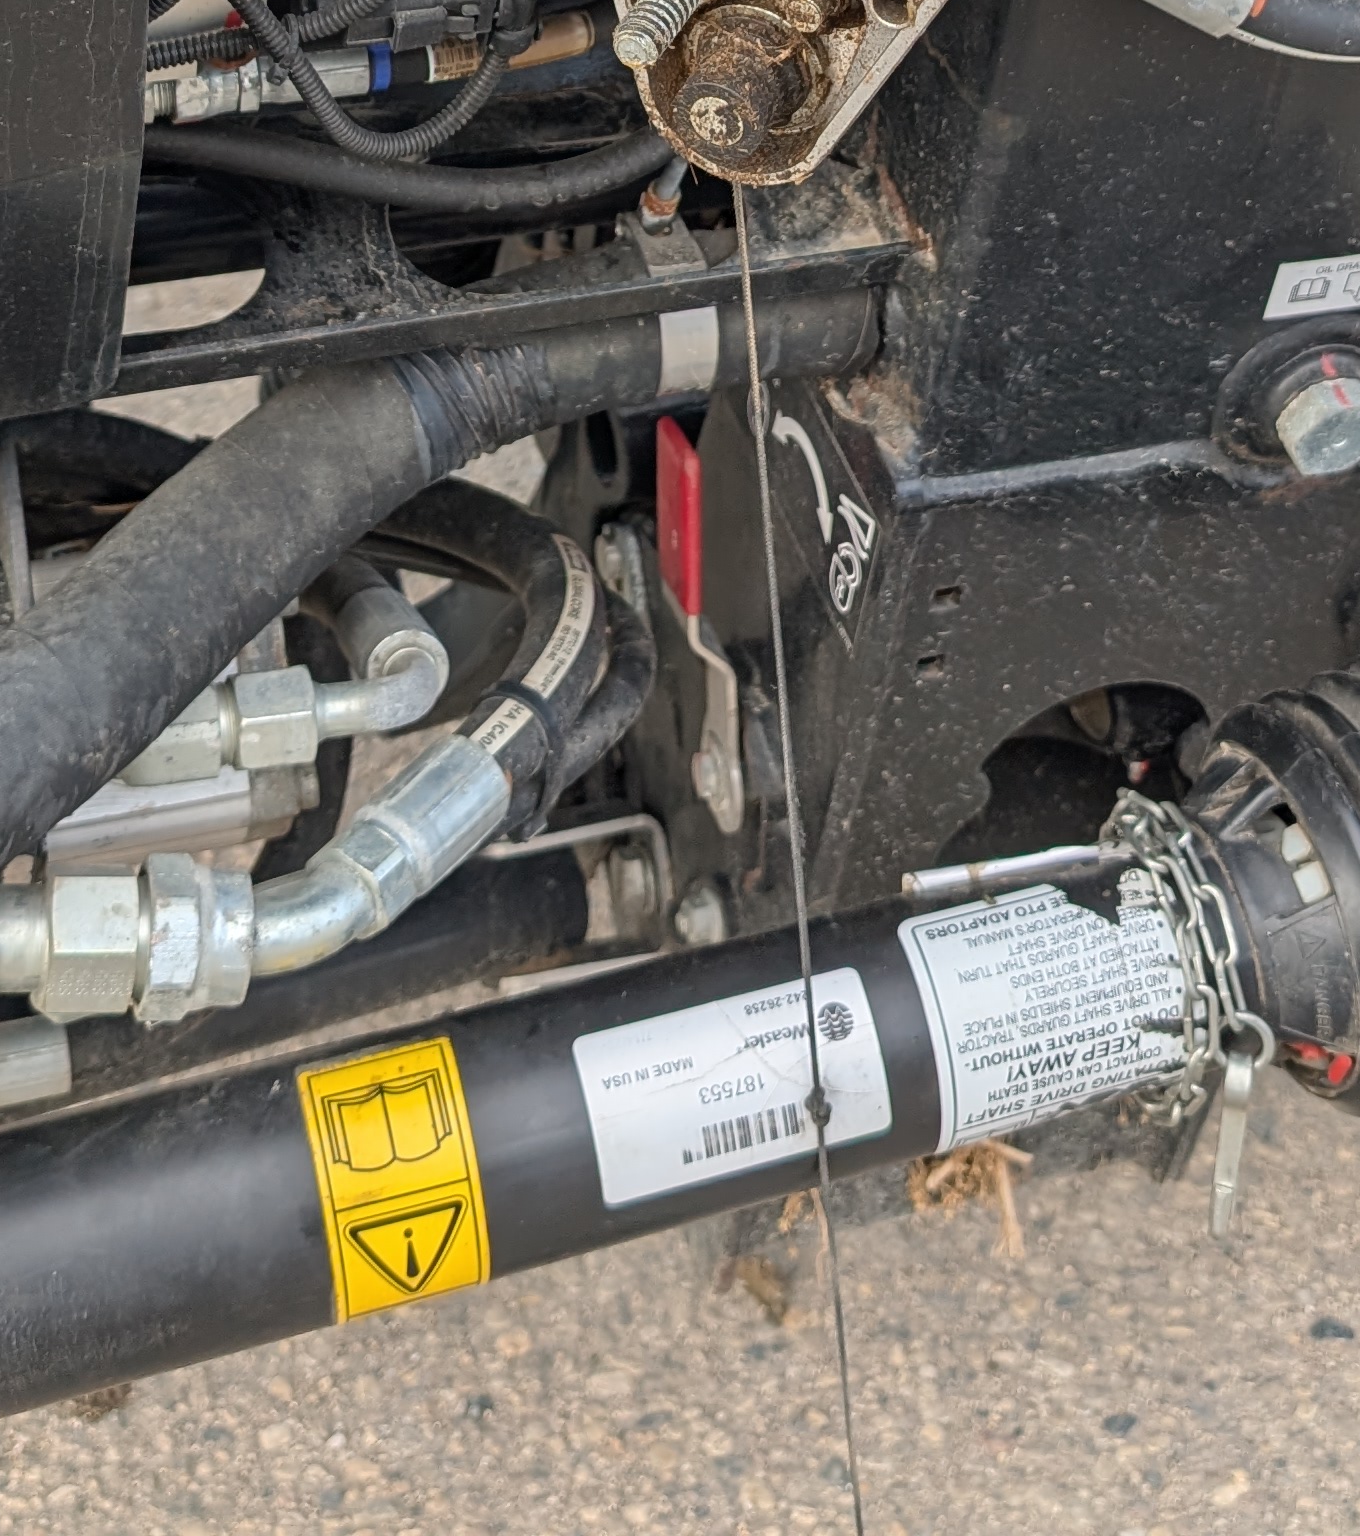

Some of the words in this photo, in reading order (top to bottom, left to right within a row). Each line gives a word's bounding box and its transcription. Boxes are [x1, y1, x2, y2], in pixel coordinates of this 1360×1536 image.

[1012, 899, 1046, 918] PTO
[923, 908, 1008, 941] ADAPTORS
[1045, 923, 1084, 945] DRIVE
[1085, 916, 1105, 932] ON
[1120, 917, 1155, 937] DRIVE
[961, 926, 1014, 949] MANUAL
[1006, 935, 1046, 957] SHAFT
[1081, 929, 1118, 951] SHAFT
[1026, 941, 1079, 966] GUARDS
[1098, 935, 1159, 963] ATTACHED
[994, 956, 1026, 975] THAT
[1044, 958, 1079, 979] BOTH
[1082, 955, 1096, 970] AT
[1129, 951, 1165, 973] DRIVE
[956, 963, 992, 984] TURN
[1009, 968, 1042, 989] ENDS
[1090, 963, 1128, 985] SHAFT
[1143, 970, 1169, 987] AND
[1024, 974, 1087, 1001] SECURELY
[1073, 976, 1142, 1007] EQUIPMENT
[1150, 986, 1171, 1002] ALL
[1019, 995, 1072, 1021] SHIELDS
[1113, 991, 1149, 1012] DRIVE
[1156, 1004, 1179, 1020] DO
[1004, 1010, 1017, 1025] IN
[1073, 1002, 1111, 1024] SHAFT
[1119, 1010, 1153, 1030] NOT
[962, 1013, 1003, 1036] PLACE
[1014, 1012, 1071, 1038] GUARDS,
[1045, 1020, 1117, 1050] OPERATE
[955, 1027, 1014, 1054] TRACTOR
[1082, 1031, 1140, 1061] KEEP
[651, 1055, 694, 1078] MADE
[1006, 1047, 1077, 1083] AWAY!
[1104, 1045, 1160, 1070] CONTACT
[633, 1066, 650, 1083] IN
[1030, 1069, 1073, 1090] CAUSE
[1075, 1061, 1102, 1077] CAN
[600, 1071, 631, 1091] USA
[696, 1071, 766, 1105] 187553
[987, 1081, 1028, 1102] DEATH
[1030, 1081, 1085, 1106] DRIVE
[963, 1098, 1024, 1124] SHAFT
